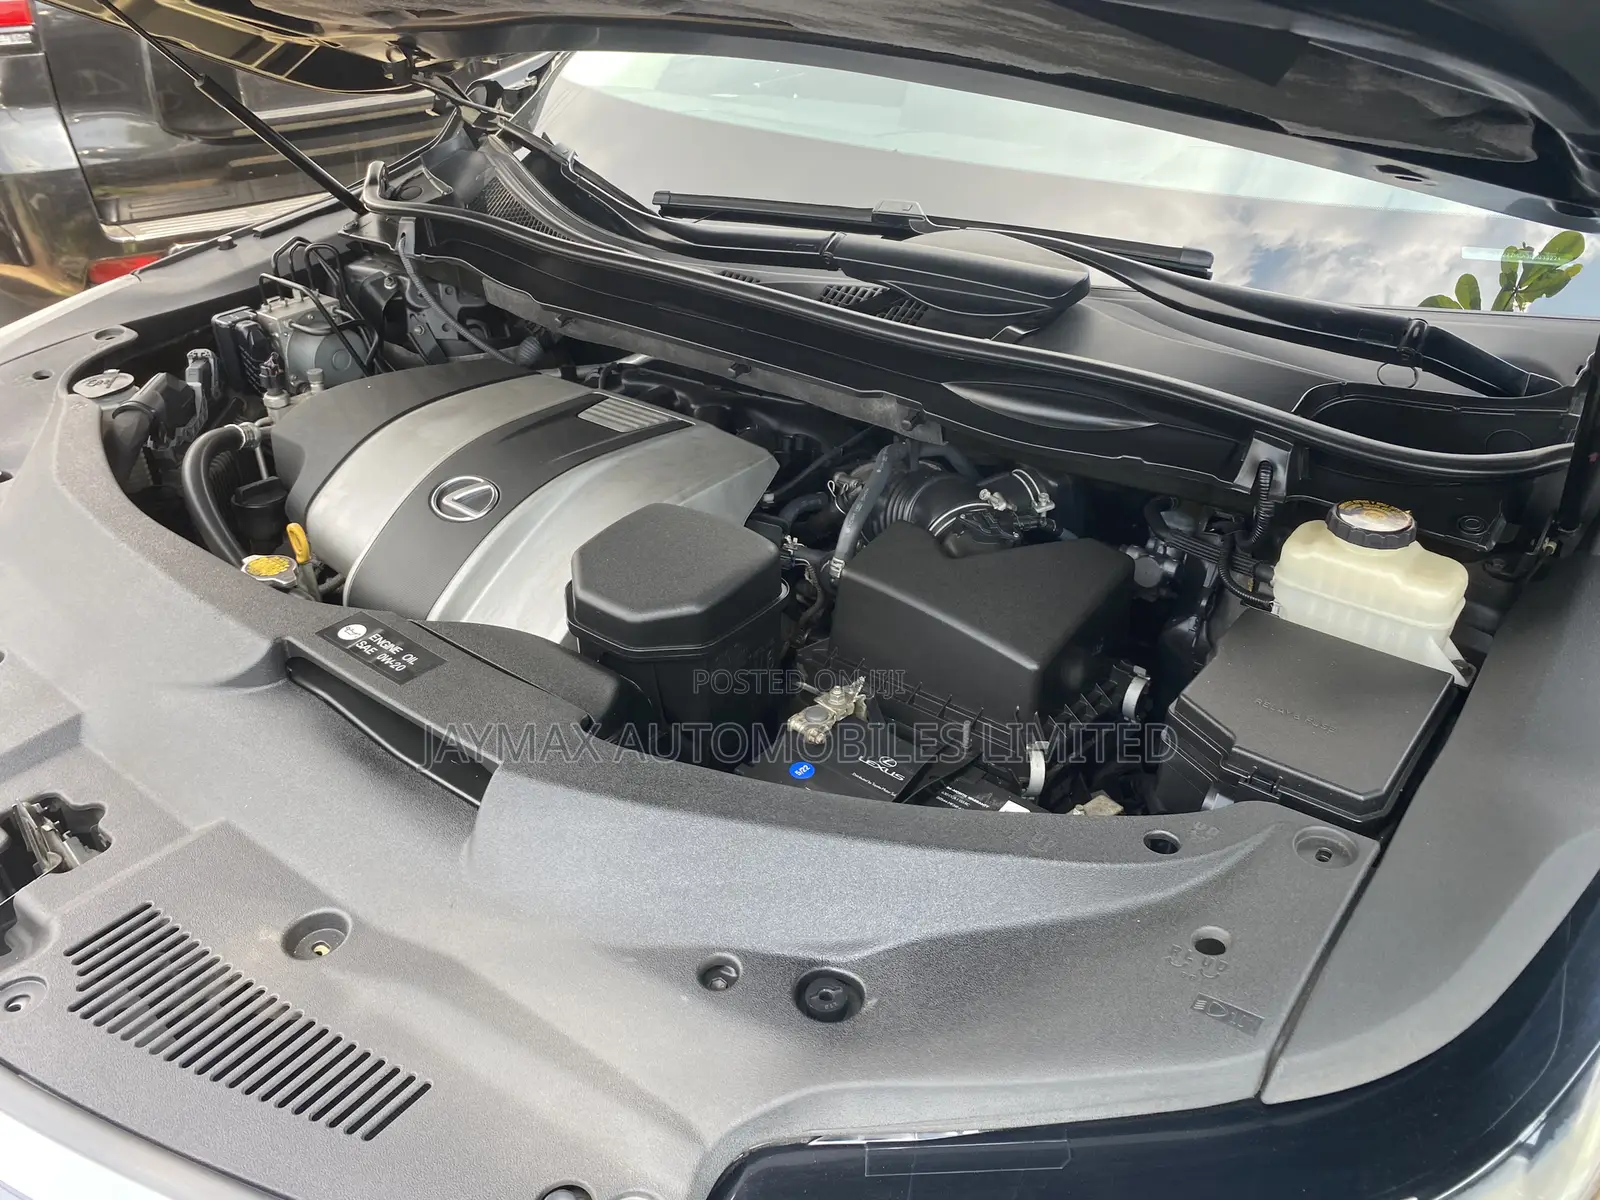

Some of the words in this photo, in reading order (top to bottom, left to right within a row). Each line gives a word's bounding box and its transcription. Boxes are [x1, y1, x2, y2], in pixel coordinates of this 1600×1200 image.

[355, 640, 379, 656] SAE
[376, 652, 407, 672] 0W-20
[368, 632, 404, 655] ENGINE
[401, 653, 419, 666] OIL
[1254, 698, 1294, 715] RELAY
[1304, 716, 1338, 734] FUSE
[857, 755, 906, 781] LEXUS
